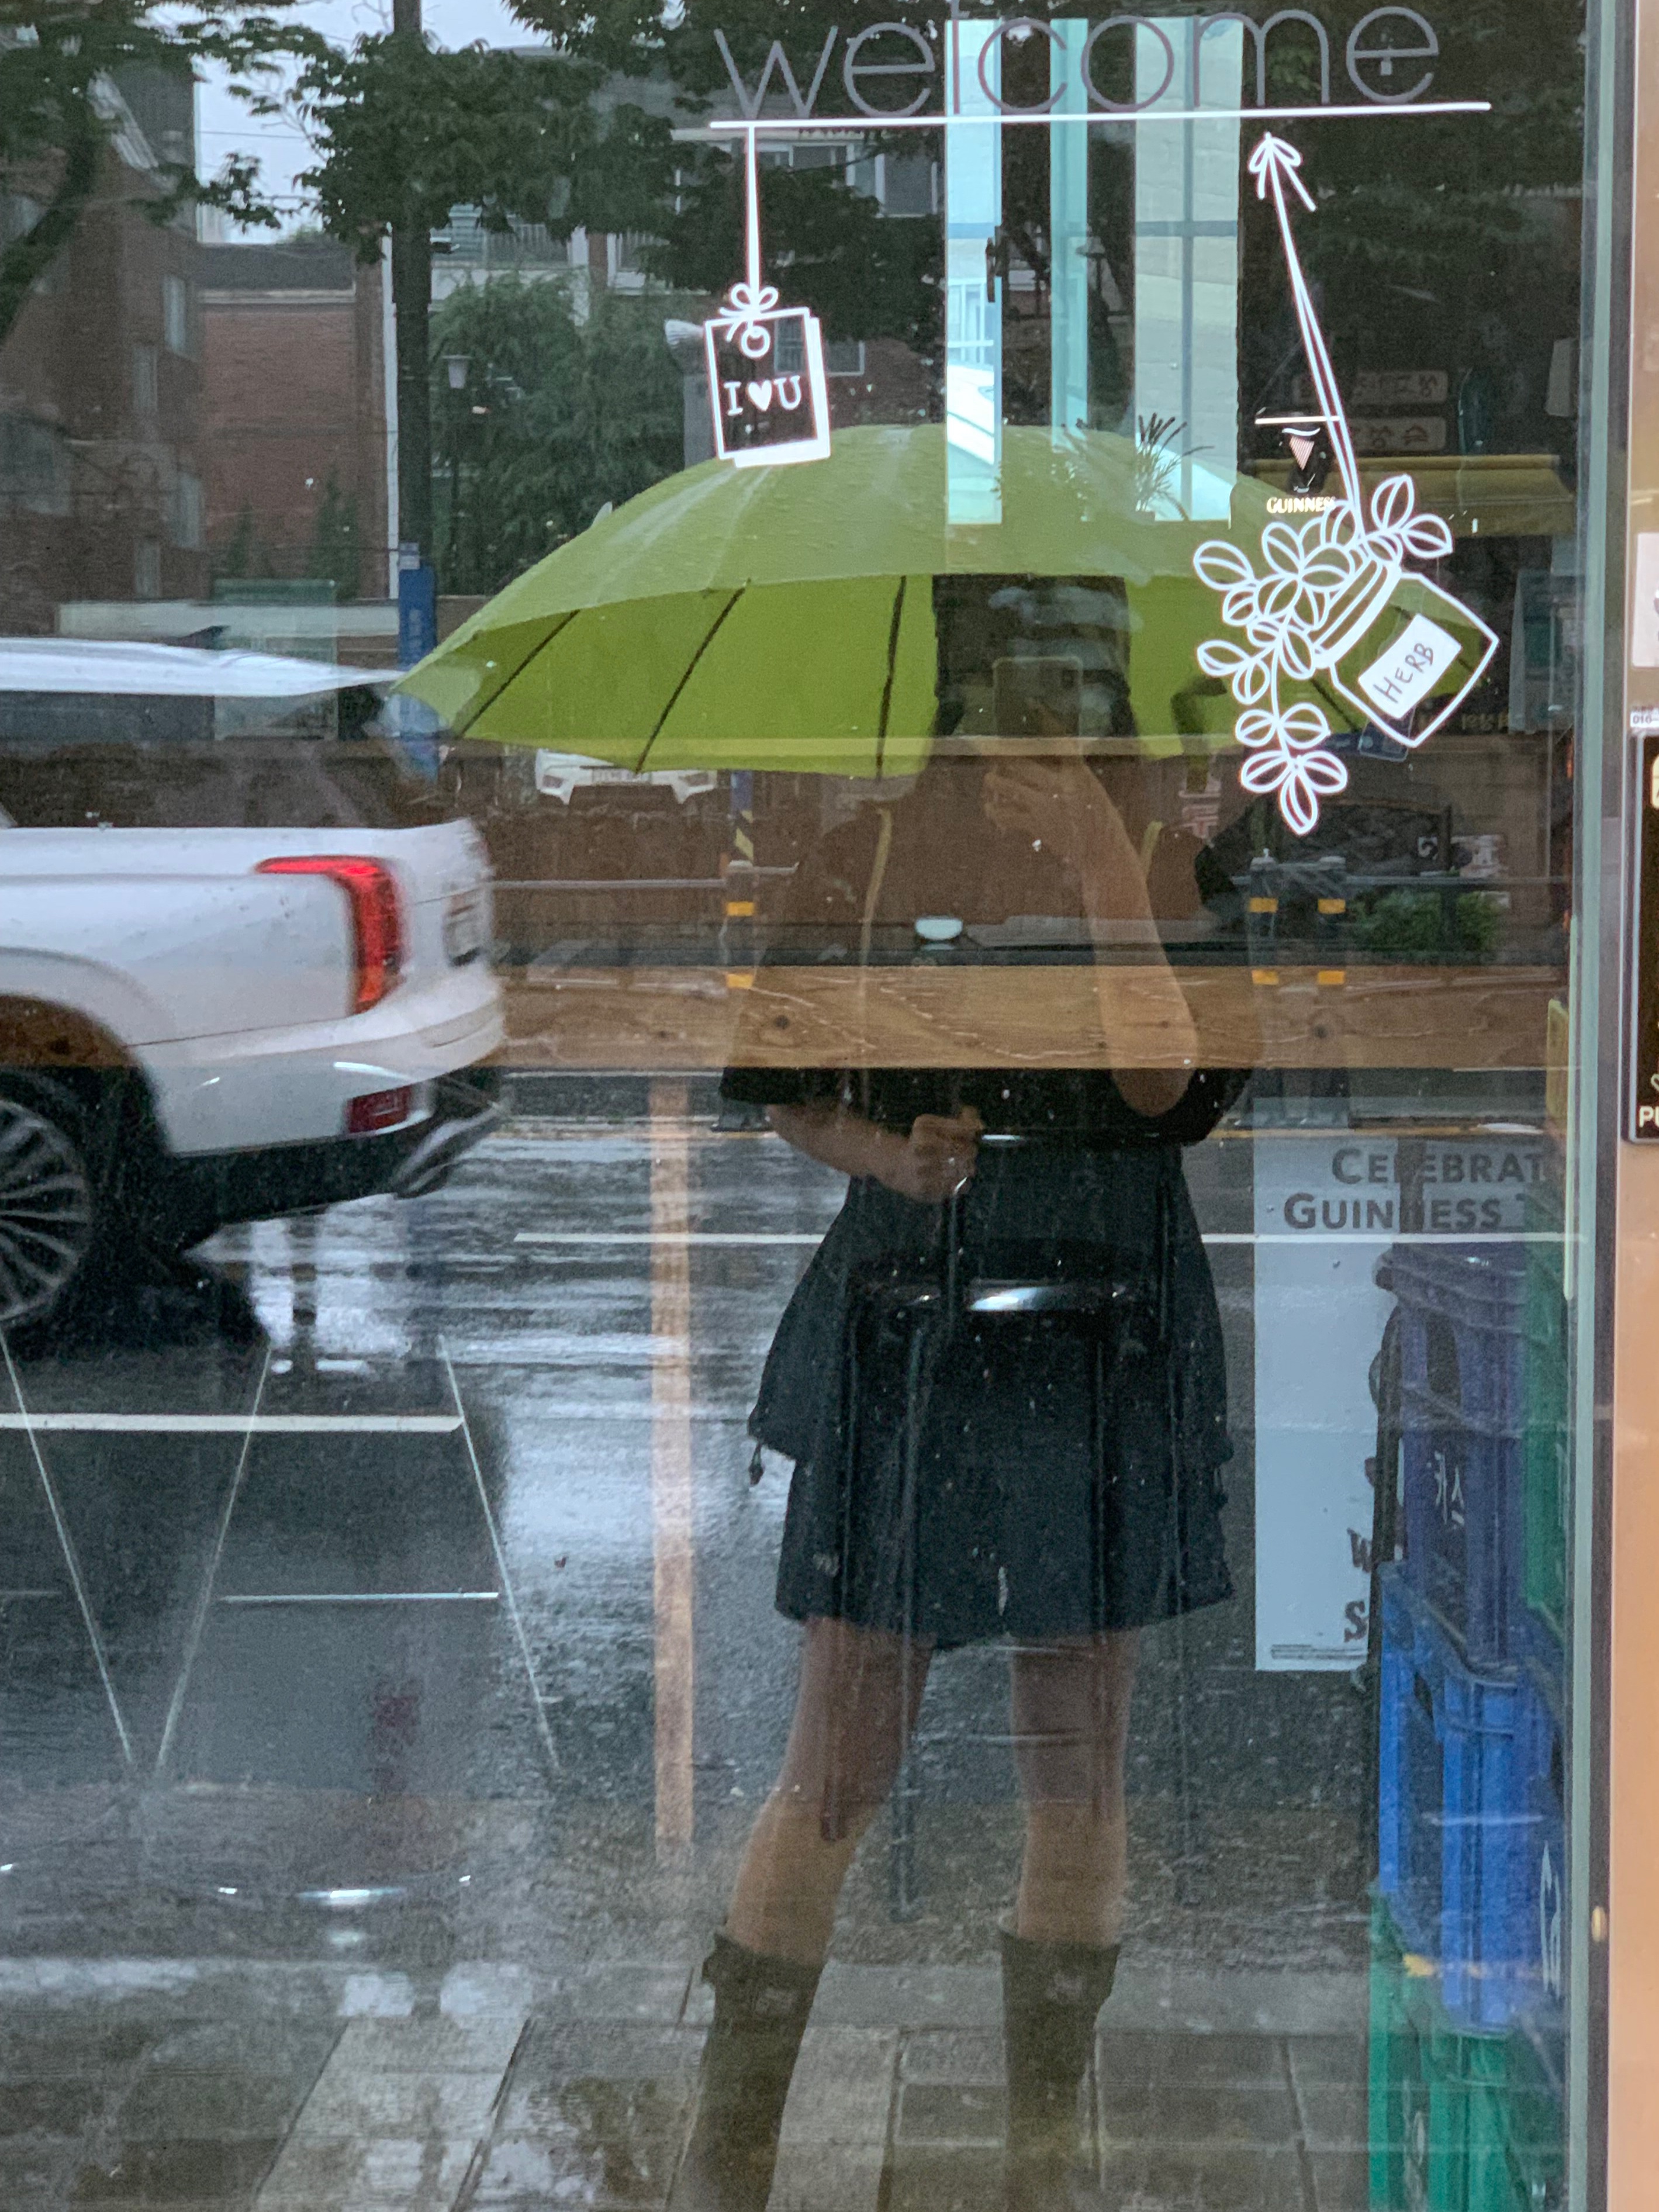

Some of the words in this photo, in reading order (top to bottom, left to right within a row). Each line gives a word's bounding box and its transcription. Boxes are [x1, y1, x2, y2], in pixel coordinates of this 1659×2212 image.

[714, 0, 1439, 118] welcome
[1373, 642, 1434, 704] HERB
[1284, 1192, 1502, 1229] GUINESS
